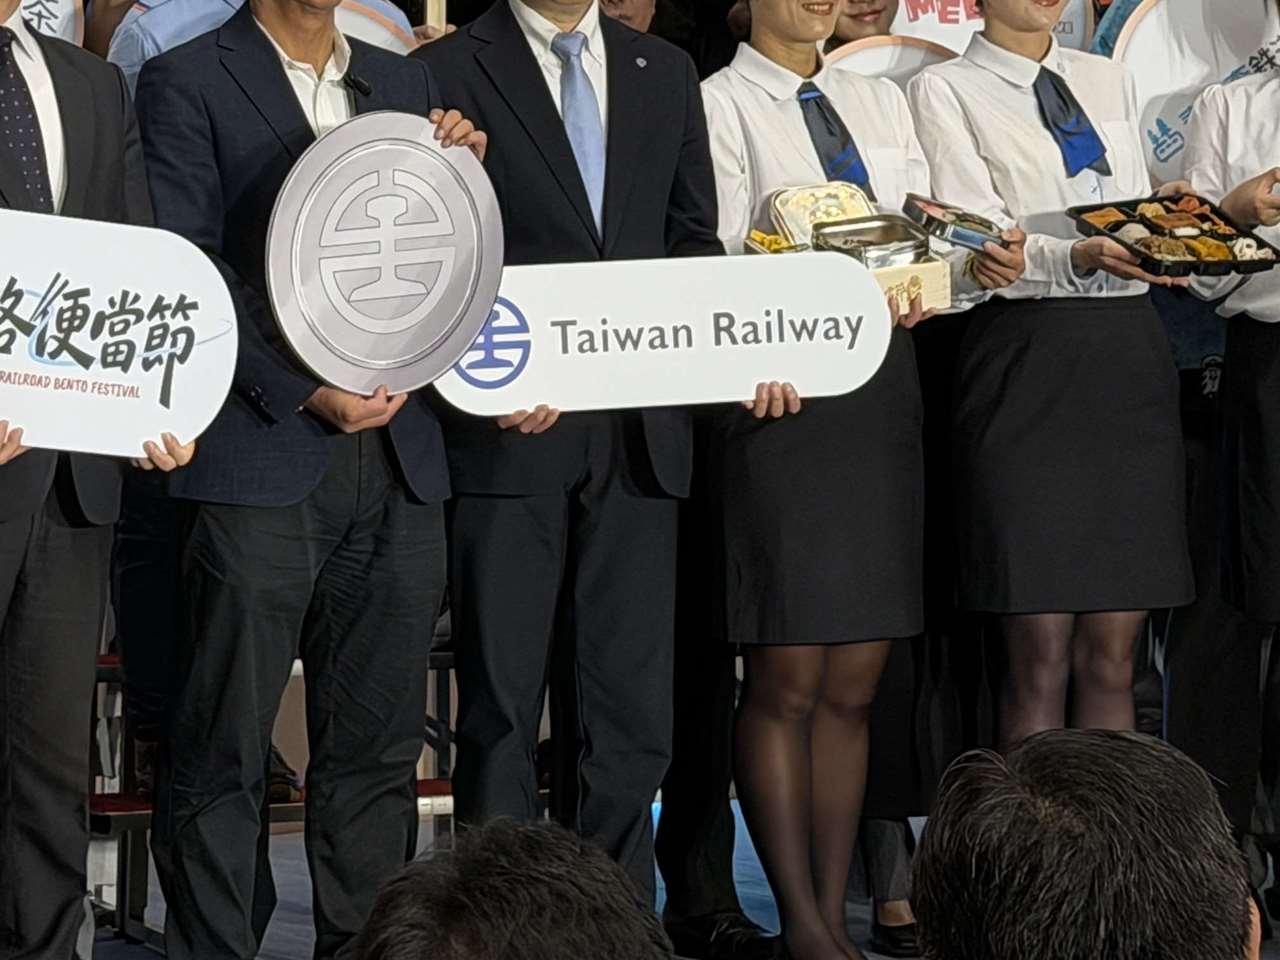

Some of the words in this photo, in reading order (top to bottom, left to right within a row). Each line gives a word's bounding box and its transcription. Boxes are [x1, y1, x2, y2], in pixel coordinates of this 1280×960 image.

[550, 318, 693, 355] Taiwan
[713, 309, 865, 351] Railway
[53, 376, 89, 392] BENTO
[91, 381, 141, 399] FESTIVAL
